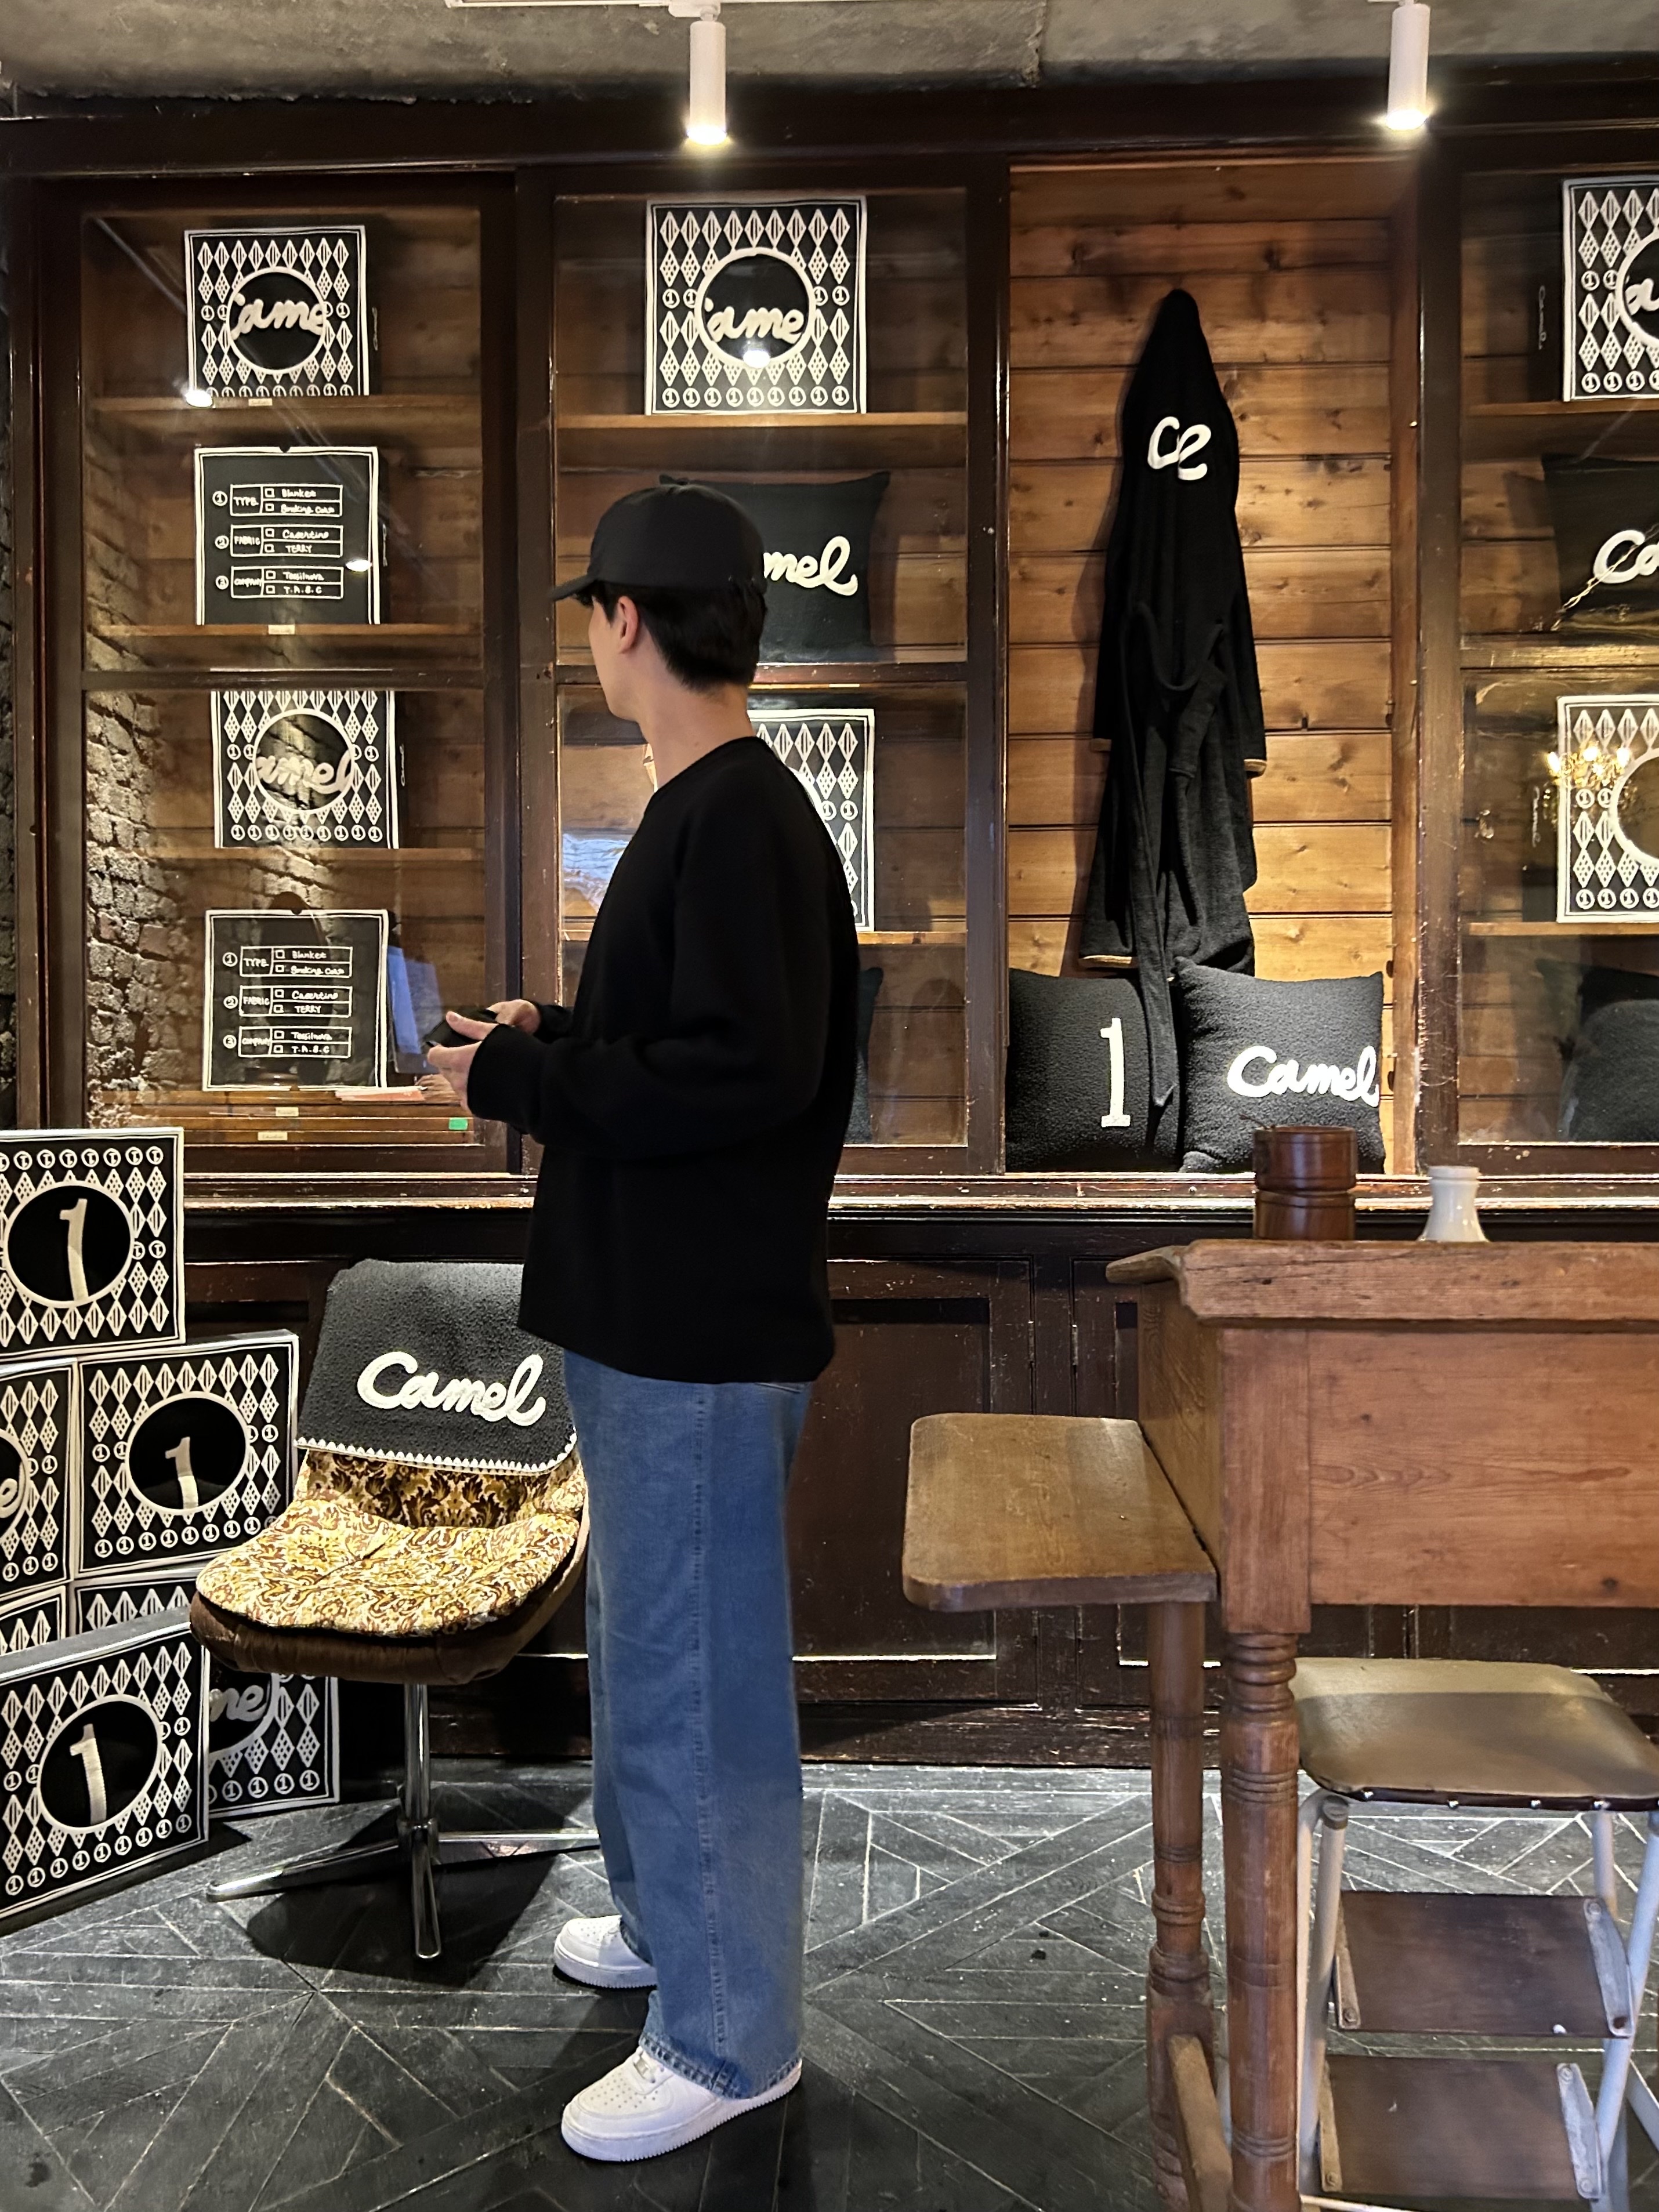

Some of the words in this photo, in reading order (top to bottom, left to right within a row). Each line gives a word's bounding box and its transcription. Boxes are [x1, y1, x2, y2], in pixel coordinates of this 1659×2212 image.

[704, 298, 804, 344] ame
[281, 488, 317, 498] Blanket
[233, 496, 259, 506] TYPE
[234, 535, 260, 545] FABRIC
[285, 544, 312, 553] TERRY
[292, 951, 327, 959] Blanket
[243, 958, 269, 967] TYPE
[243, 996, 270, 1005] FABRIC
[294, 1005, 321, 1013] TERRY
[1100, 1017, 1131, 1127] 1
[1226, 1045, 1380, 1108] Camel
[60, 1198, 89, 1301] 1
[357, 1351, 546, 1427] Camel
[165, 1436, 199, 1509] 1
[69, 1723, 107, 1825] 1
